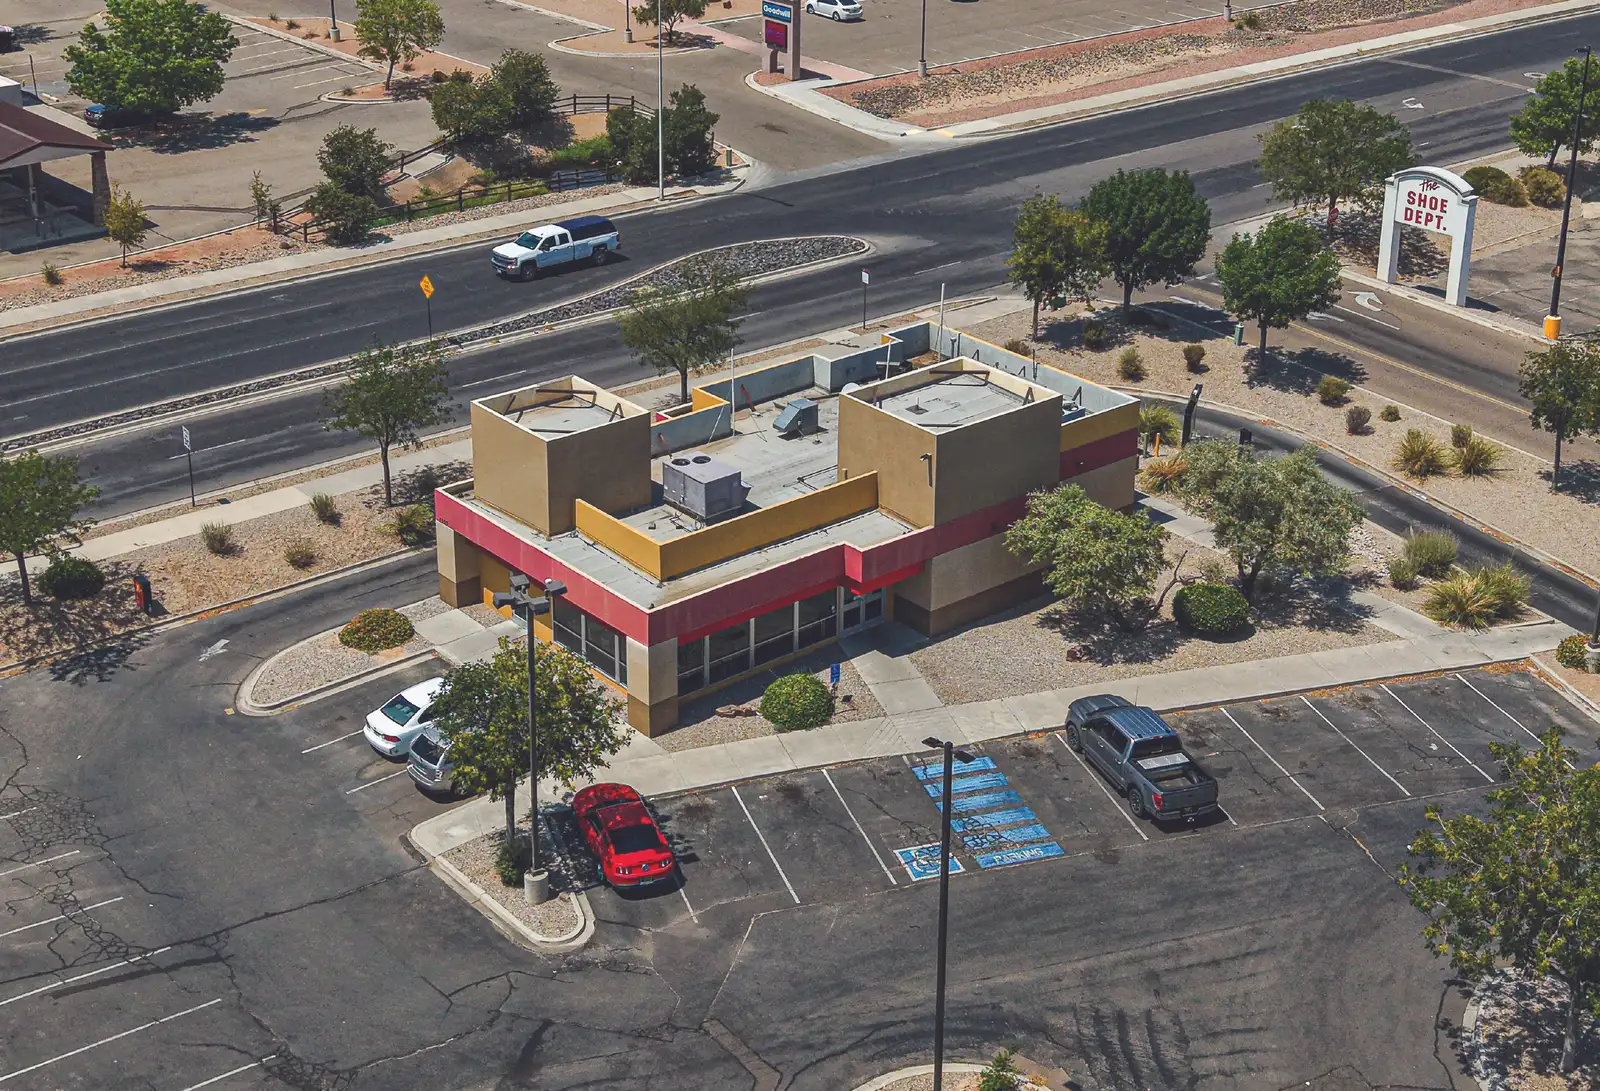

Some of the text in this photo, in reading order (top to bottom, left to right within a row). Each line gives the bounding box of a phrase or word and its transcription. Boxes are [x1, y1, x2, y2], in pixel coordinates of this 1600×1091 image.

[763, 4, 791, 18] Goodwill
[1406, 190, 1449, 214] SHOE
[1403, 206, 1447, 231] DEPT.
[993, 847, 1044, 865] PARKING
